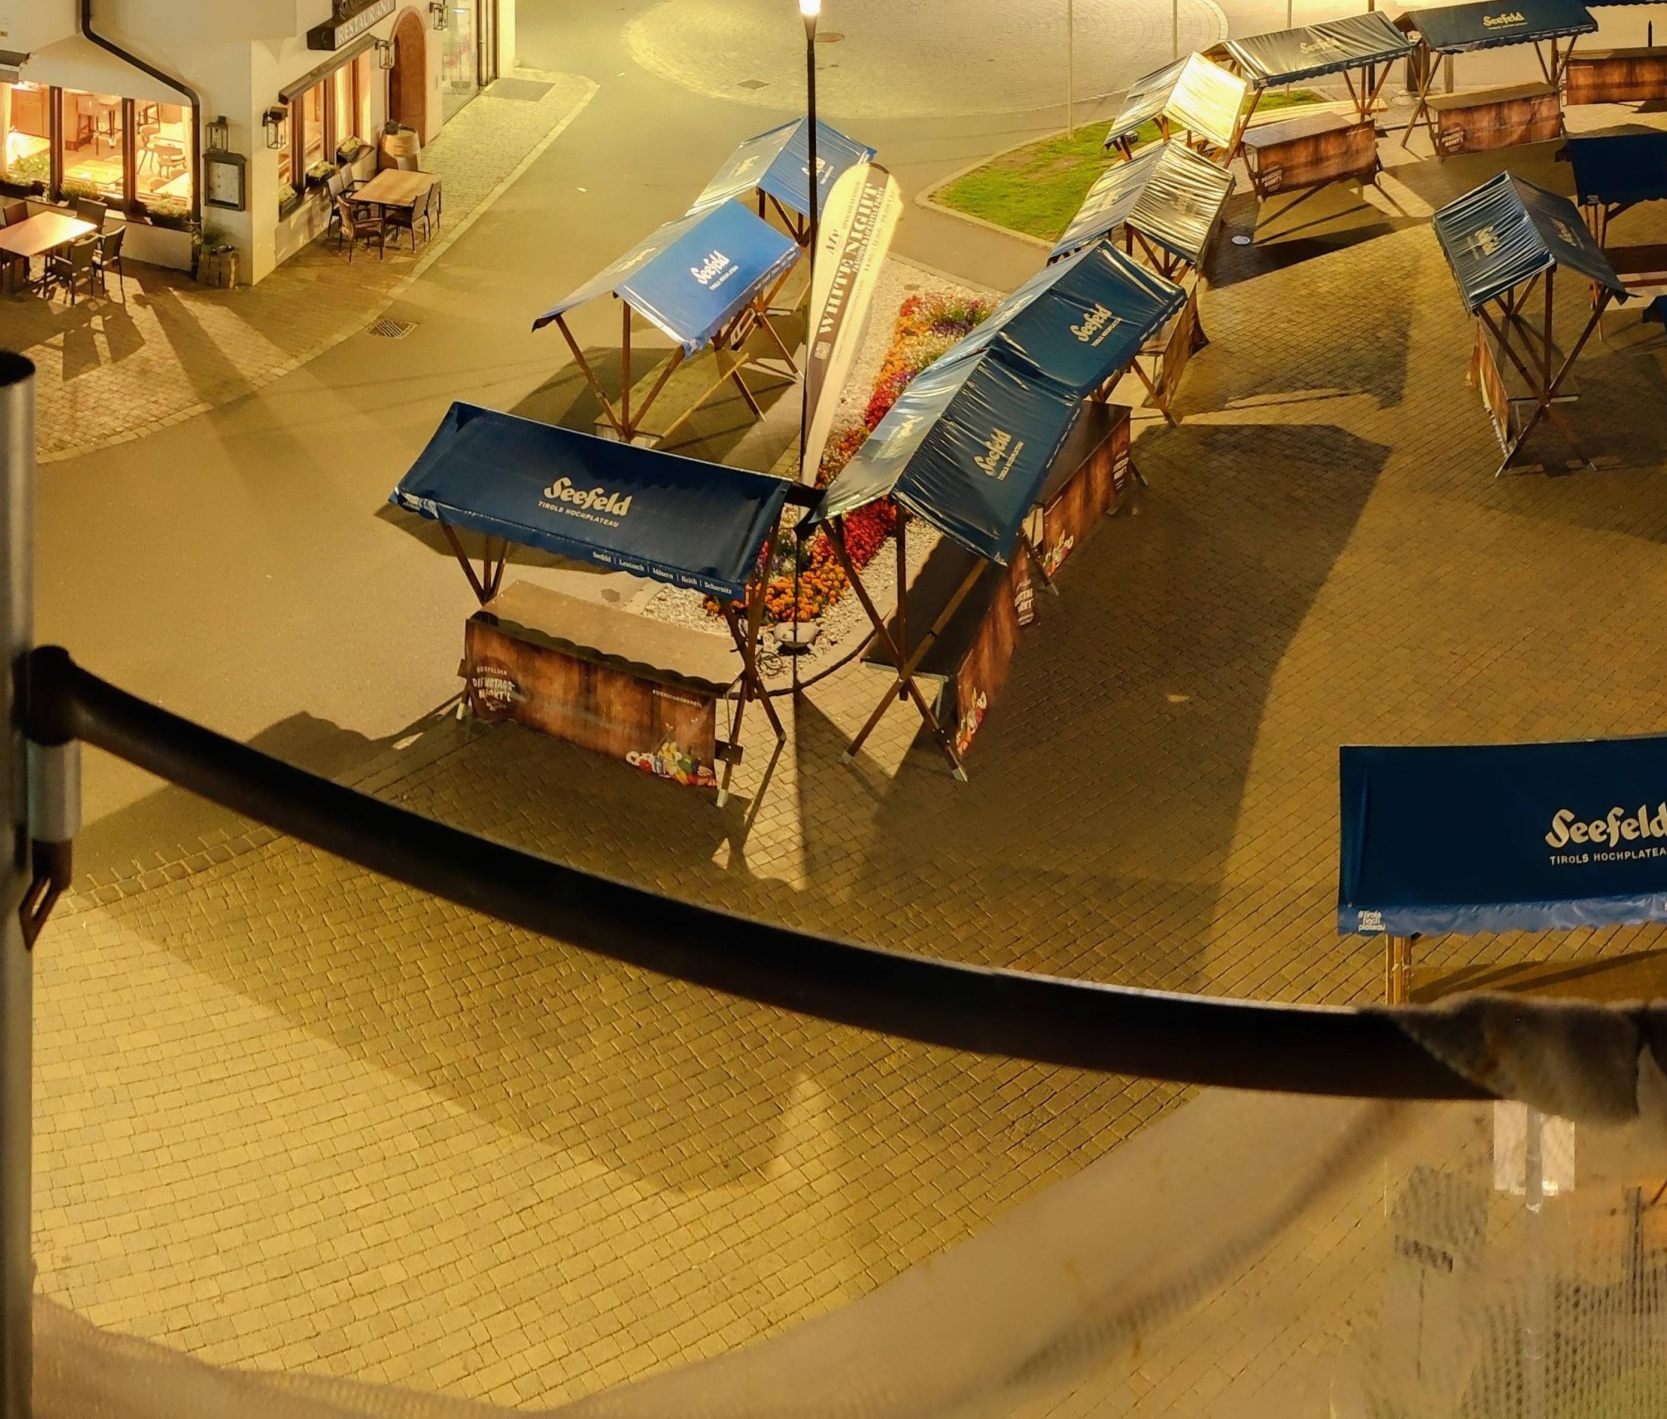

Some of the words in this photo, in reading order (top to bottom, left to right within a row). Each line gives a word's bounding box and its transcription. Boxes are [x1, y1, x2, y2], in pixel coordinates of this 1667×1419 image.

[1483, 11, 1526, 27] Seefeld
[686, 250, 731, 286] Seefeld
[818, 259, 854, 336] WHITE
[843, 182, 878, 265] NIGHT
[1069, 302, 1113, 343] Seefeld
[974, 426, 1013, 477] Seefeld
[537, 500, 565, 514] TIROLS
[564, 507, 620, 529] HOCHPLATEAU
[543, 476, 634, 518] Seefeld
[1549, 851, 1590, 866] TIROLS
